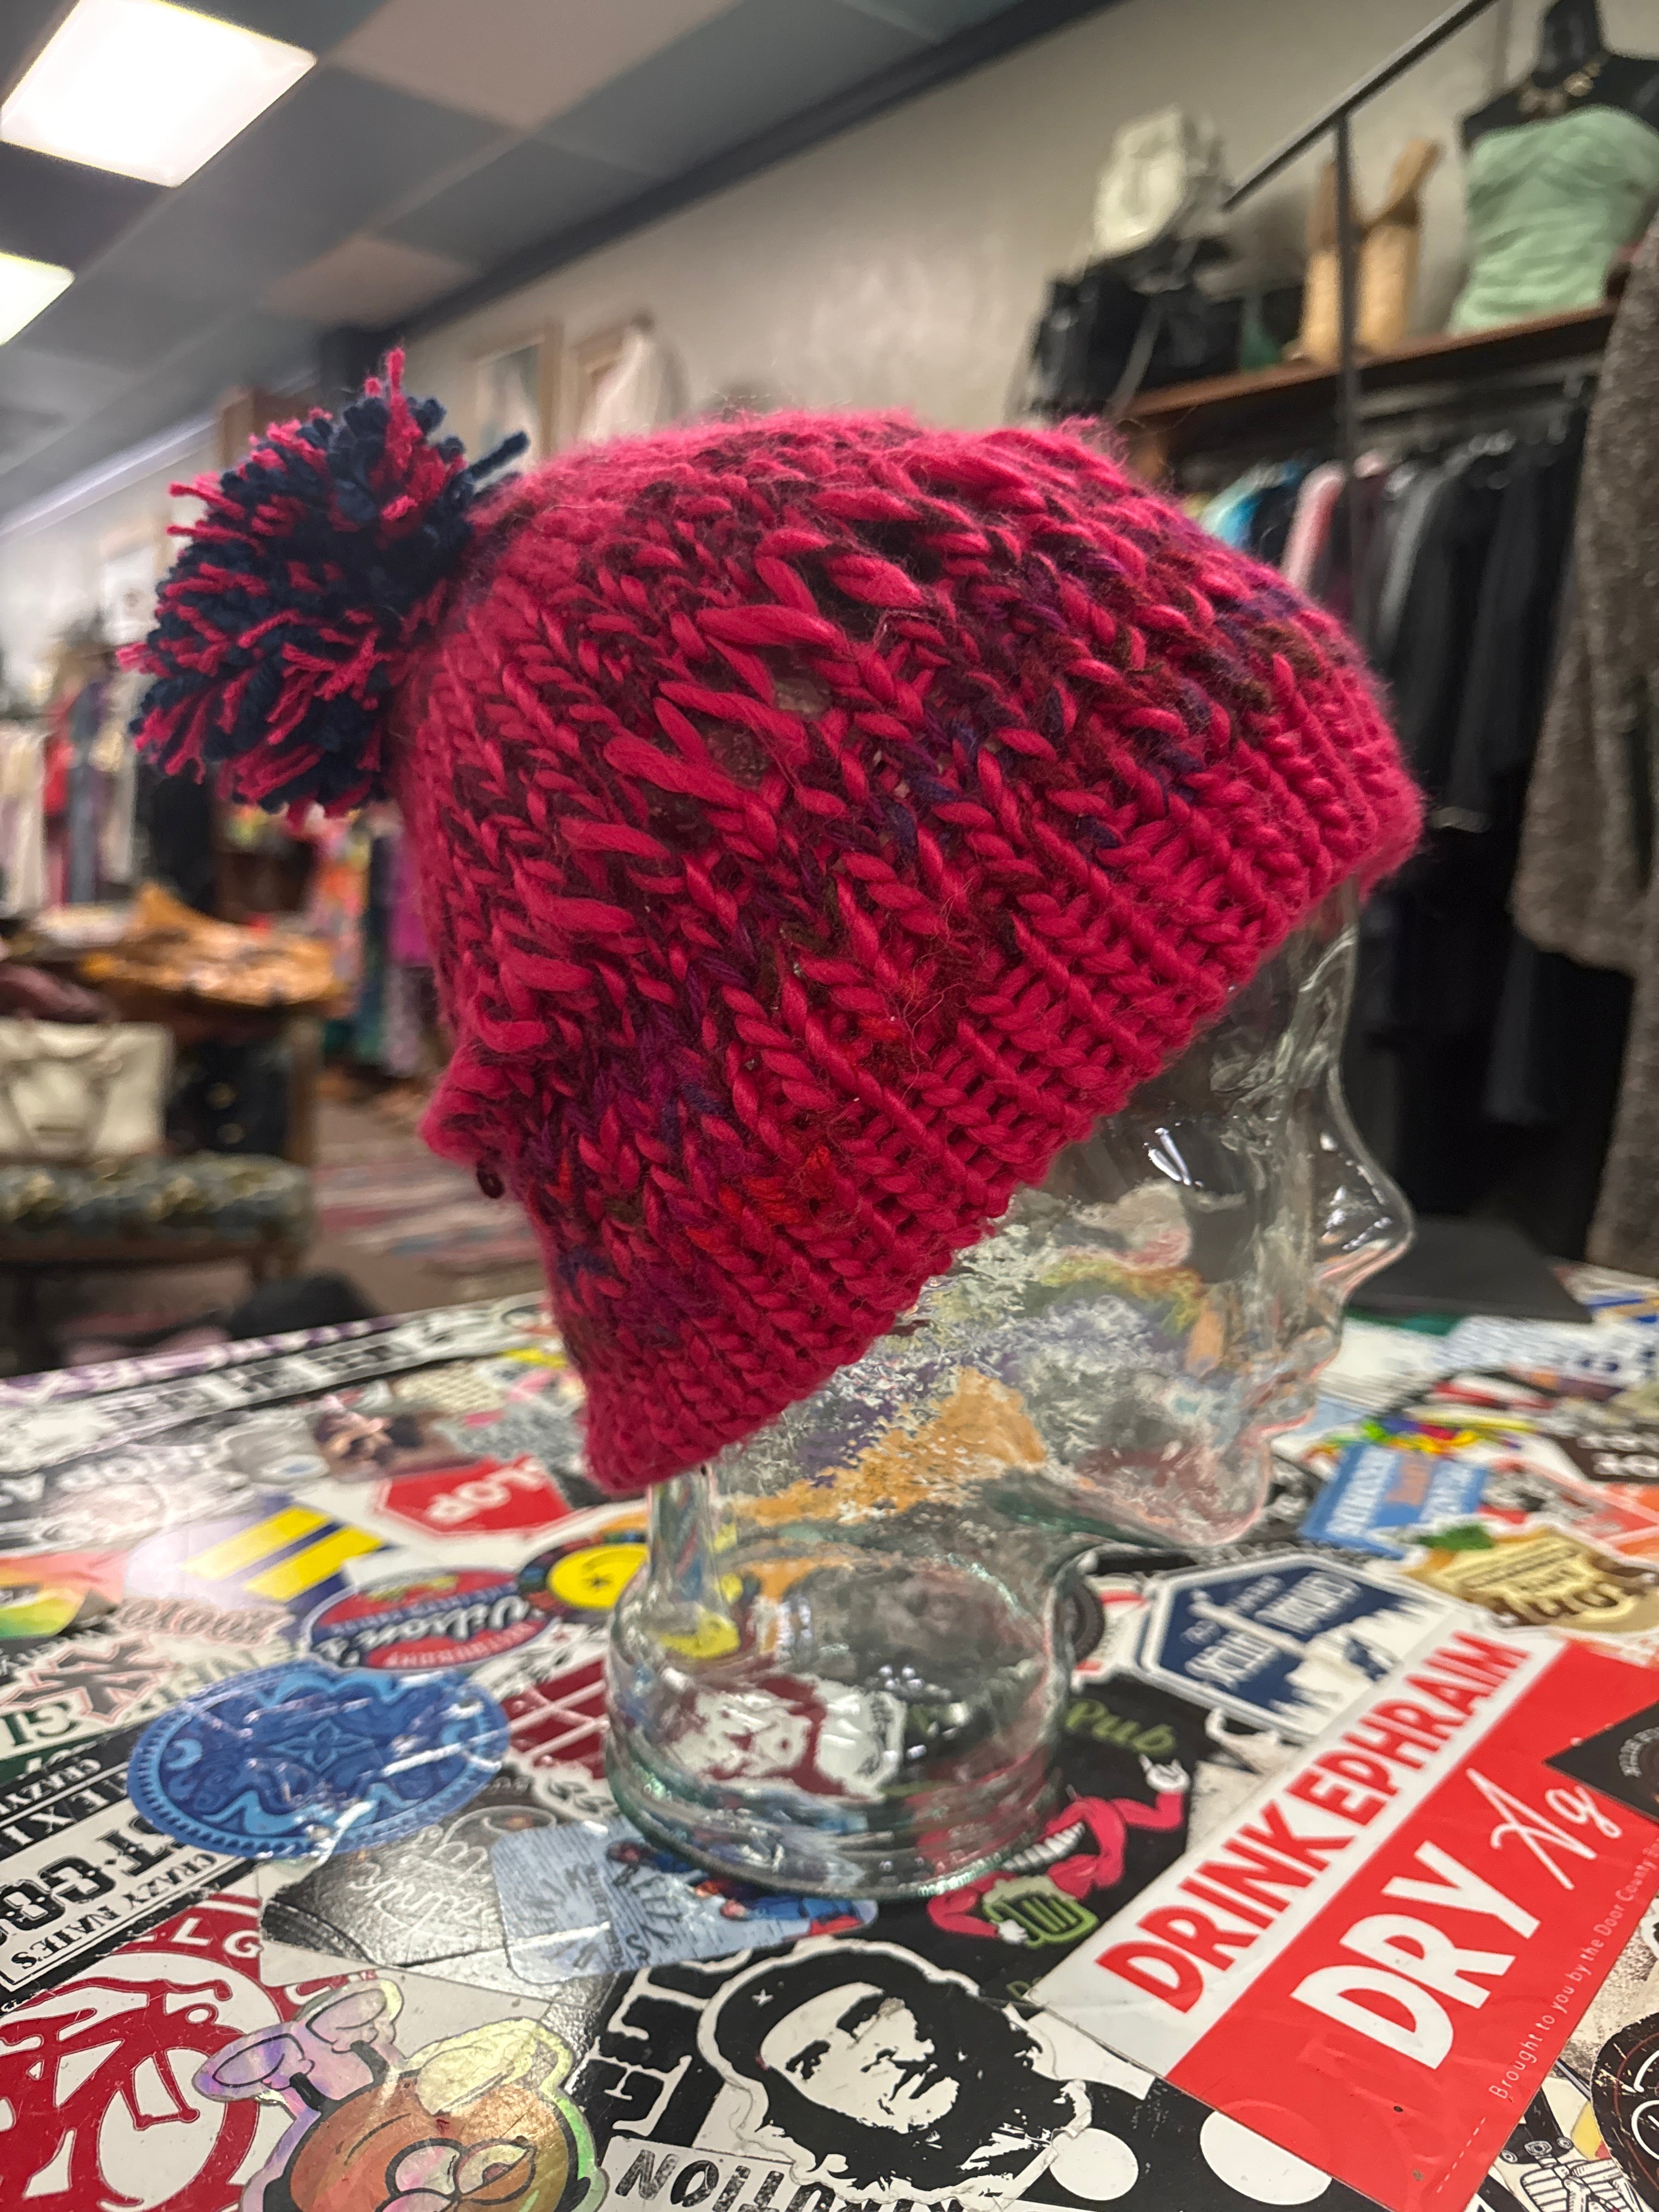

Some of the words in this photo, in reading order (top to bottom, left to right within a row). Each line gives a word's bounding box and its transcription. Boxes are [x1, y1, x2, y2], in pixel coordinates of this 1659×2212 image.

[1065, 1698, 1177, 1757] Pub
[0, 1759, 101, 1813] CRAZY
[1095, 1801, 1358, 2013] DRINK
[1285, 1631, 1532, 1827] EPHRAIM
[122, 1853, 218, 1910] CRAZY
[11, 1905, 121, 1970] NATE'S
[1290, 1840, 1541, 2070] DRY
[1488, 2033, 1543, 2100] Brought
[1536, 2014, 1555, 2032] to
[1552, 1984, 1576, 2015] you
[1564, 1960, 1592, 1983] by
[1581, 1938, 1605, 1962] the
[1593, 1903, 1624, 1937] Door
